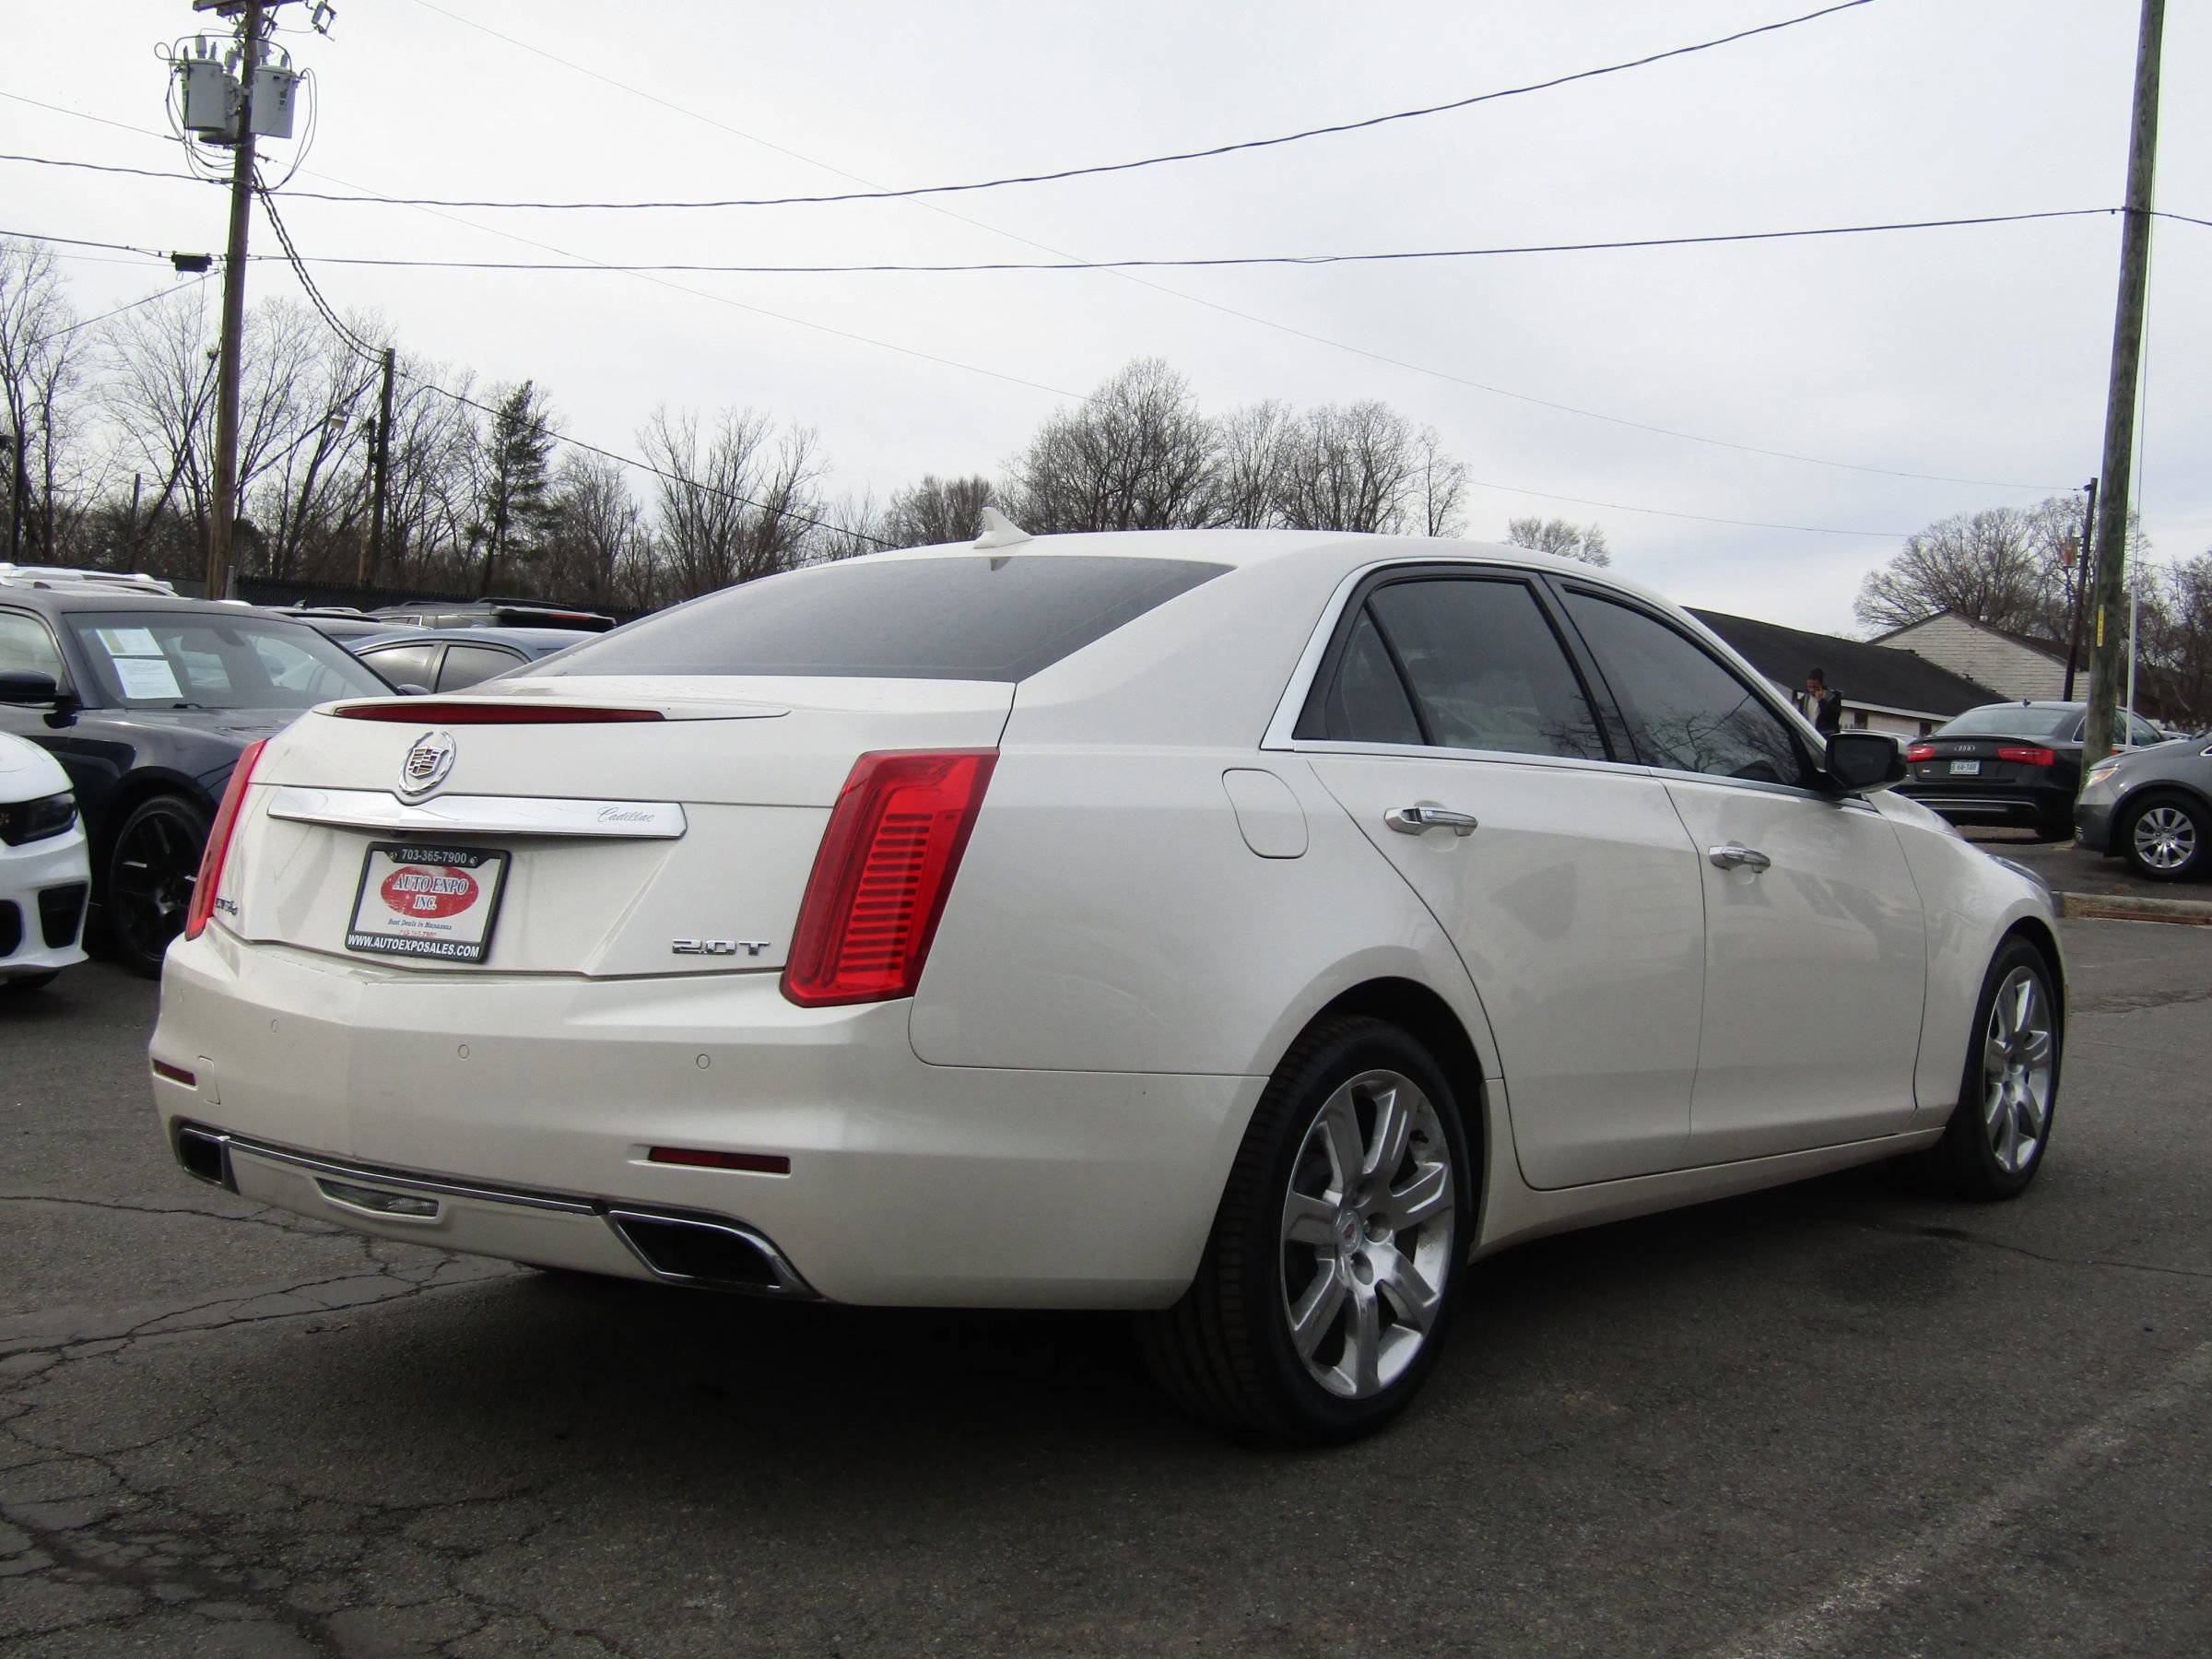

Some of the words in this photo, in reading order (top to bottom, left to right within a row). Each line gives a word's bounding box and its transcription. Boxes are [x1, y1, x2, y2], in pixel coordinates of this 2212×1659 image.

[597, 806, 655, 823] Cadillac
[402, 849, 467, 865] 703-365-7900
[393, 874, 431, 892] AUTO
[431, 877, 469, 895] EXPO
[413, 895, 438, 910] INC.
[347, 934, 480, 958] WWW.AUTOEXPOSALES.COM
